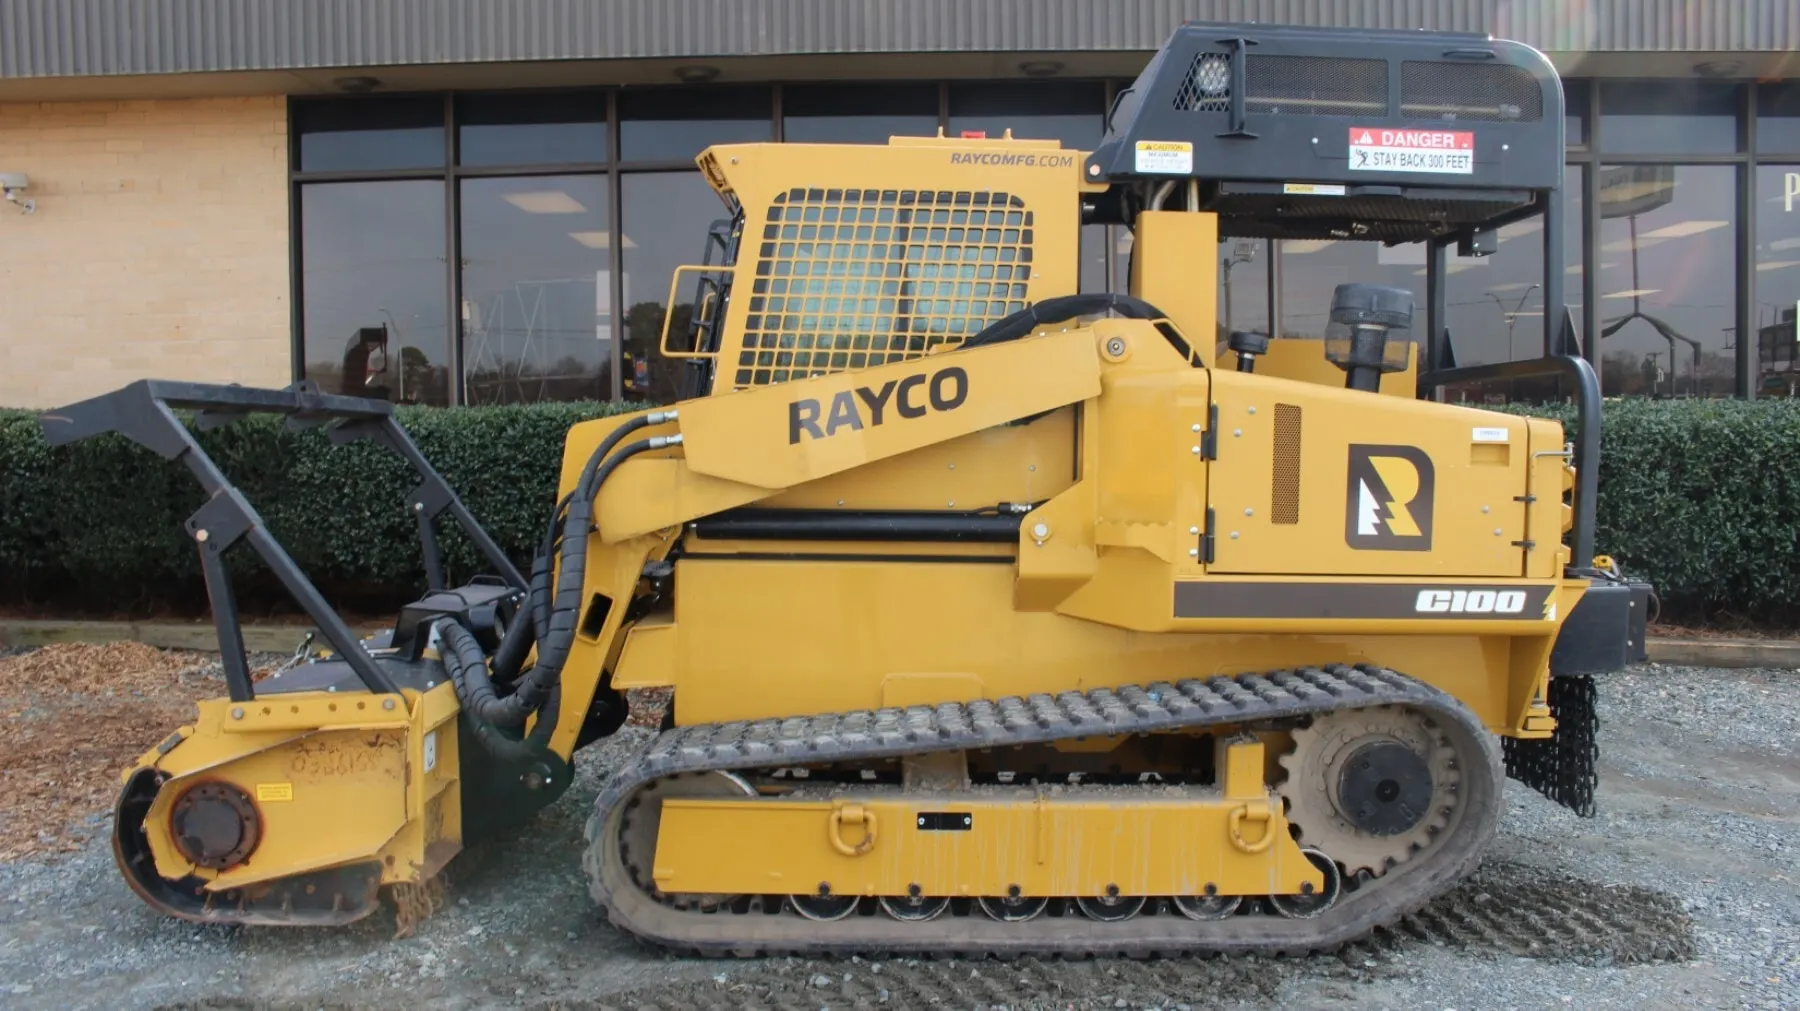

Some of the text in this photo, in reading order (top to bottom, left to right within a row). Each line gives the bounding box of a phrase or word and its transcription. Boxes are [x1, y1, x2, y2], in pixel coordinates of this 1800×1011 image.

[1381, 131, 1455, 148] DANGER
[950, 153, 1073, 167] RAYCOMFG.COM
[1373, 152, 1470, 169] STAY BACK 300 FEET
[788, 366, 969, 445] RAYCO
[1415, 590, 1527, 613] C100
